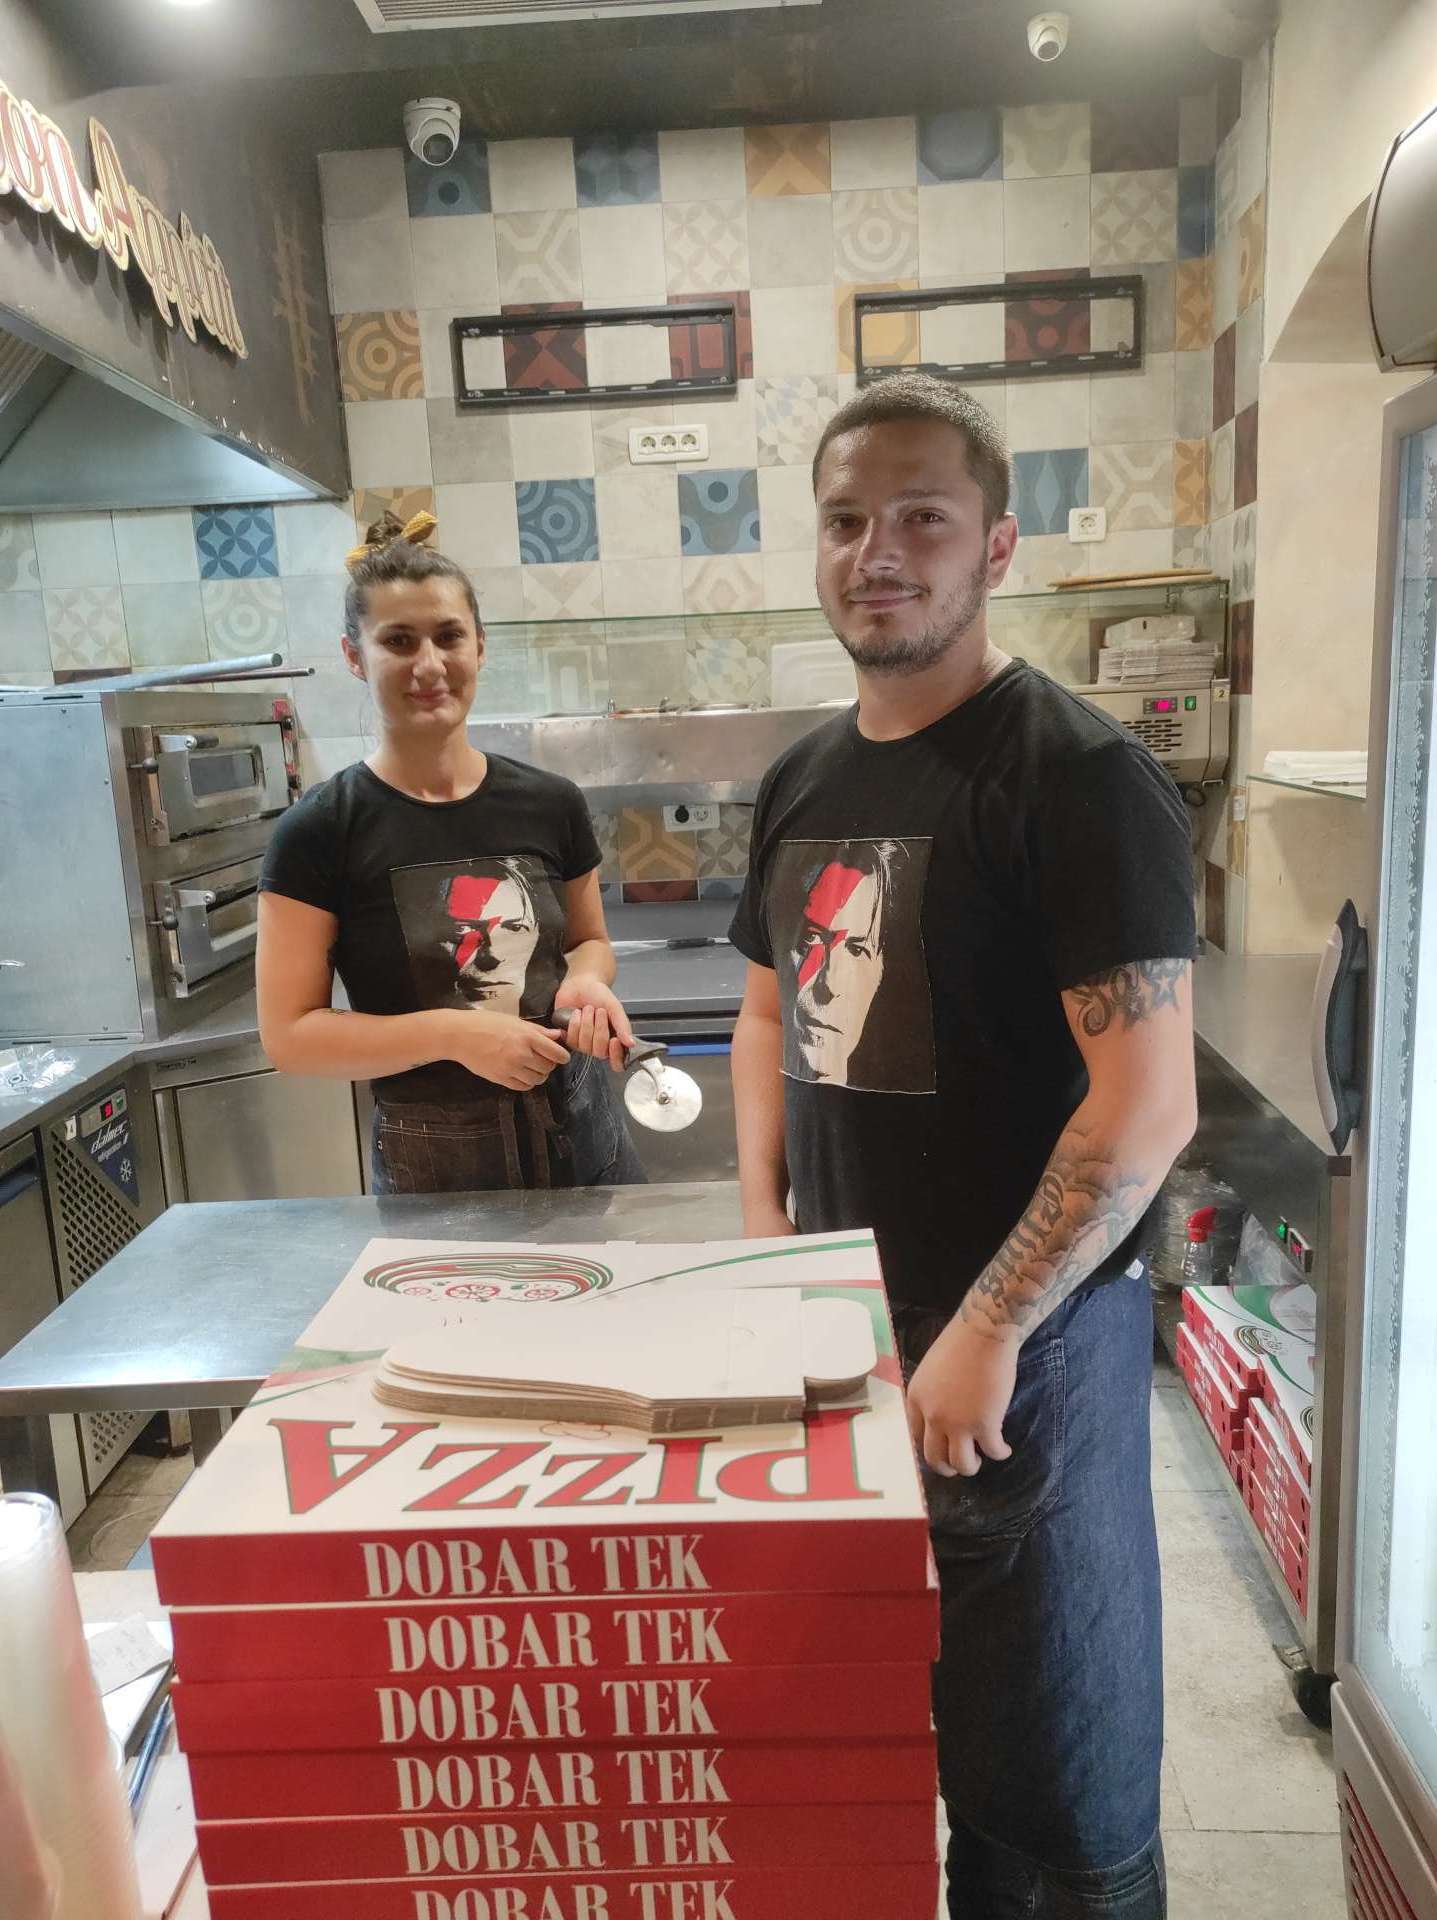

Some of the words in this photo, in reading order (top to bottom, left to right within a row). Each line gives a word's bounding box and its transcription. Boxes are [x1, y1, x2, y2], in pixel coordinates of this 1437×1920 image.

[0, 80, 99, 246] on
[267, 1405, 884, 1515] PIZZA
[359, 1537, 577, 1598] DOBAR
[591, 1534, 712, 1592] TEK
[384, 1610, 599, 1673] DOBAR
[613, 1607, 732, 1666] TEK
[374, 1683, 587, 1744] DOBAR
[601, 1678, 719, 1737] TEK
[392, 1752, 601, 1812] DOBAR
[616, 1748, 732, 1806] TEK
[400, 1821, 606, 1875] DOBAR
[620, 1816, 735, 1867] TEK
[411, 1884, 612, 1920] DOBAR
[629, 1880, 739, 1920] TEK
